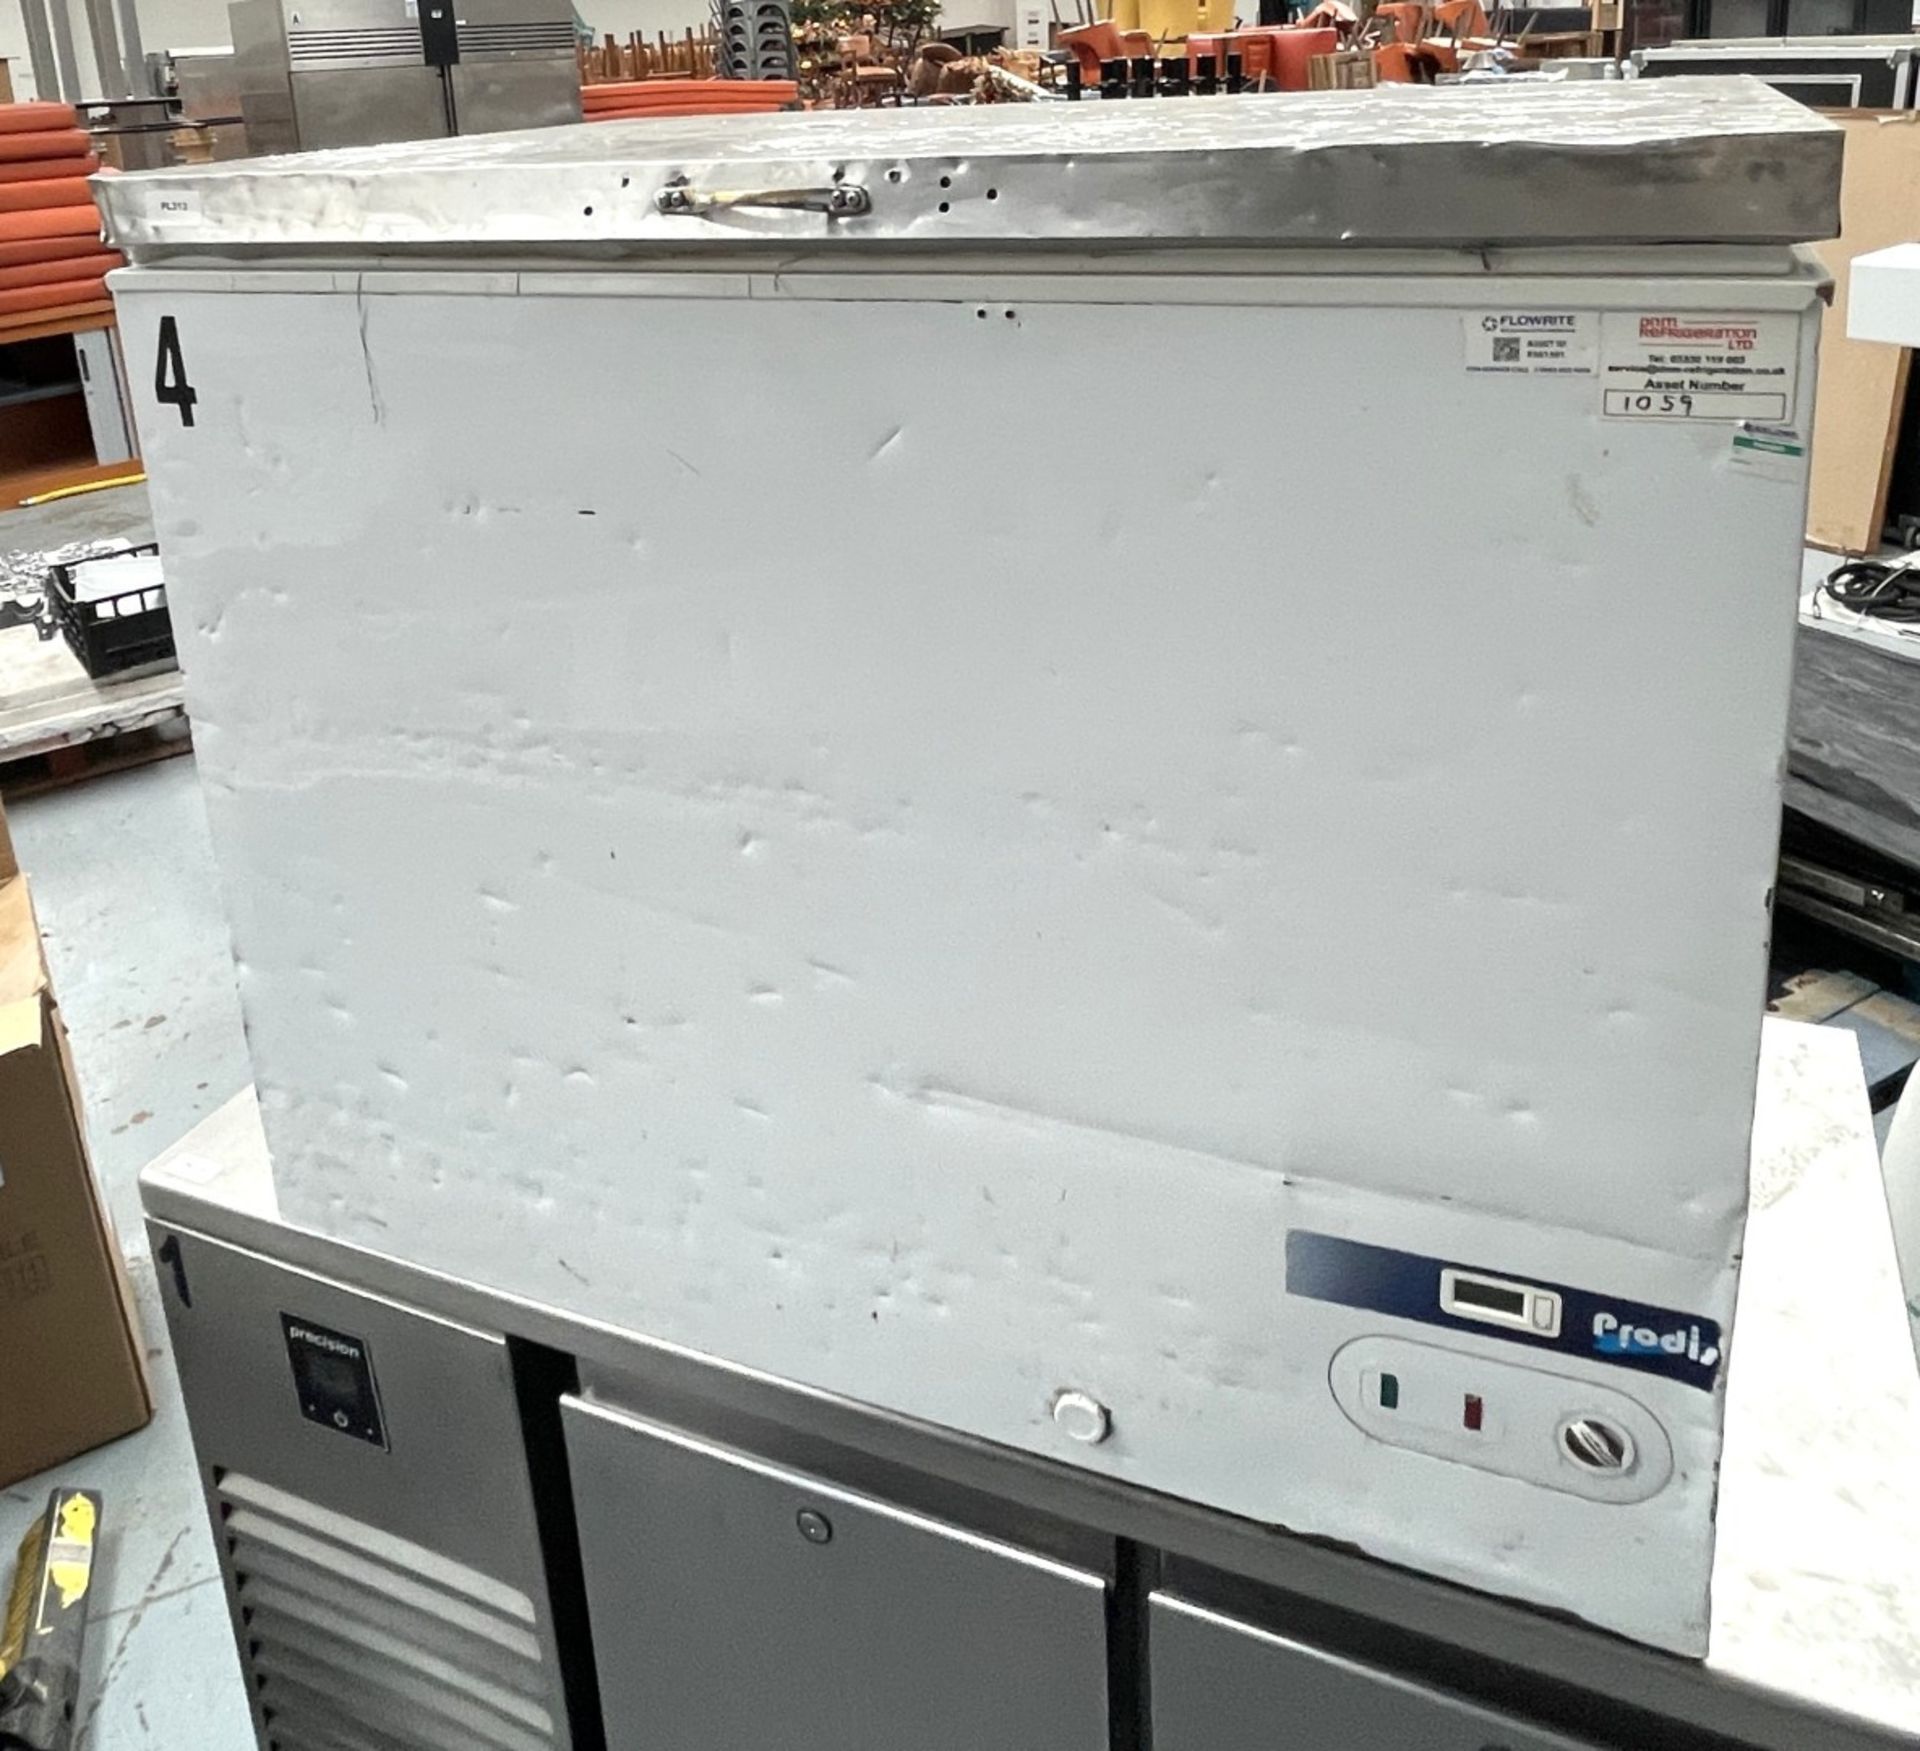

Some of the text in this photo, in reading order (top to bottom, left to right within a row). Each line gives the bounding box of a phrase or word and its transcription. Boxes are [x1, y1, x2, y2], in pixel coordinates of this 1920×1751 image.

[1500, 315, 1575, 326] FLOWRITE
[155, 315, 198, 427] 4
[1645, 379, 1746, 391] Asset Number
[290, 1326, 359, 1358] precision
[1593, 1312, 1719, 1366] Prodis
